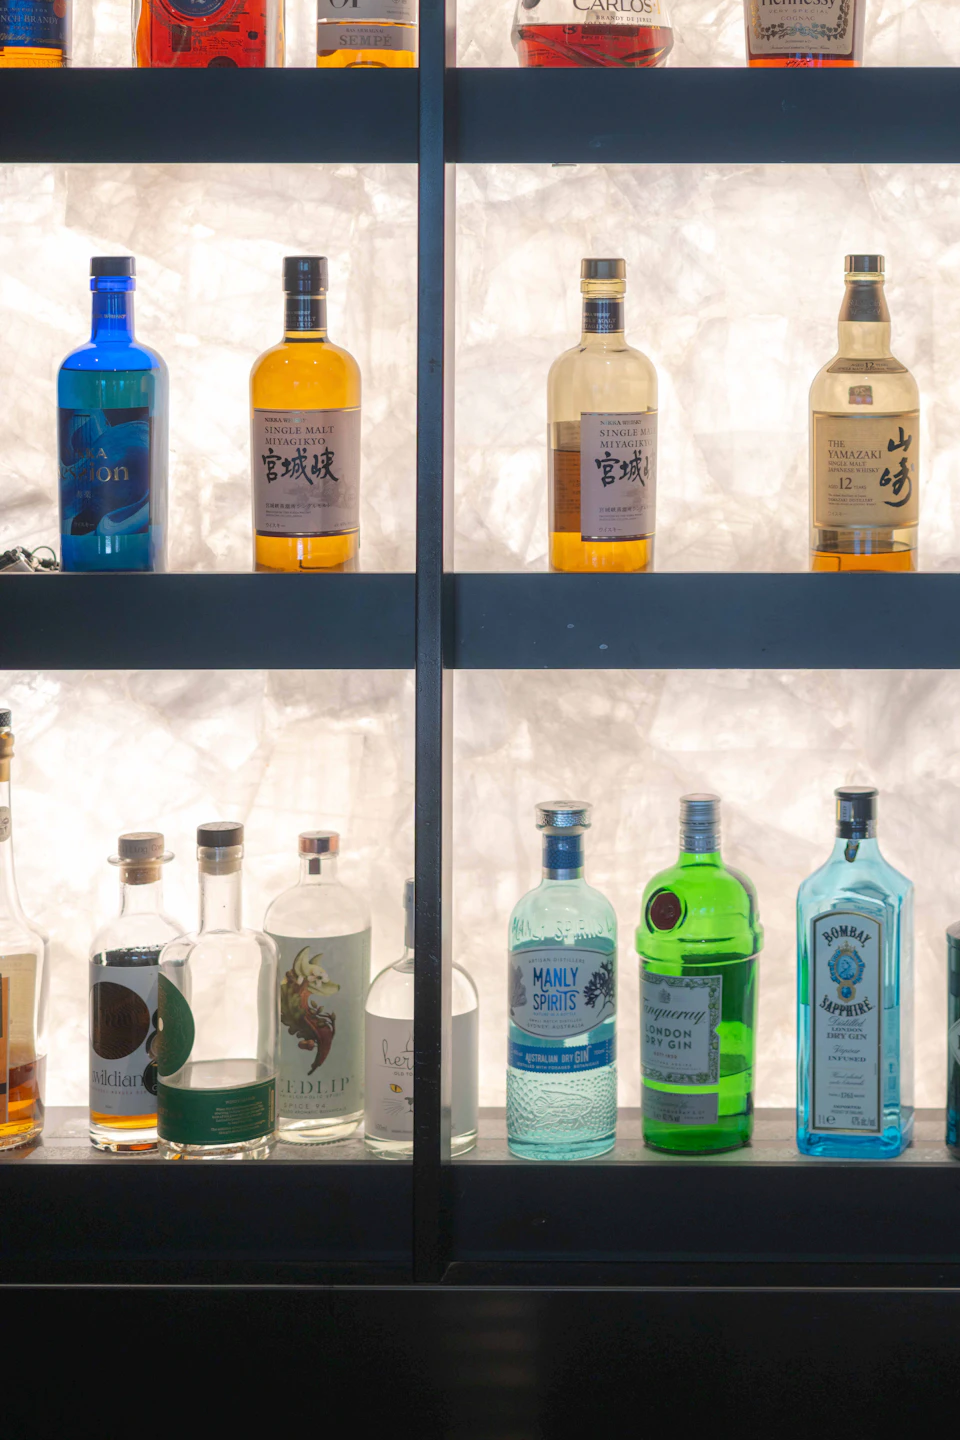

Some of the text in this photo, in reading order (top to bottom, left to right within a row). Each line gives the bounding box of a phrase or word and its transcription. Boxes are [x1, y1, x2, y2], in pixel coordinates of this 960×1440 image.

[24, 15, 58, 25] BRANDY
[338, 34, 392, 47] SEMPÉ
[264, 426, 334, 434] SINGLE MALT
[600, 429, 638, 437] SINGLE
[264, 438, 326, 446] MIYAGIKYO
[828, 440, 845, 448] THE
[828, 450, 882, 460] YAMAZAKI
[838, 477, 852, 490] 12
[822, 925, 872, 949] BOMBAY
[533, 966, 579, 992] MANLY
[533, 990, 580, 1011] SPIRITS
[818, 994, 874, 1017] SAPPHIRE
[828, 1016, 867, 1028] Distilled
[646, 1024, 692, 1039] LONDON
[848, 1032, 868, 1040] GIN
[668, 1040, 692, 1050] GIN
[832, 1044, 860, 1054] Vapour
[526, 1046, 592, 1063] AUSTRALIAN DRY GIN
[828, 1055, 866, 1063] INFUSED
